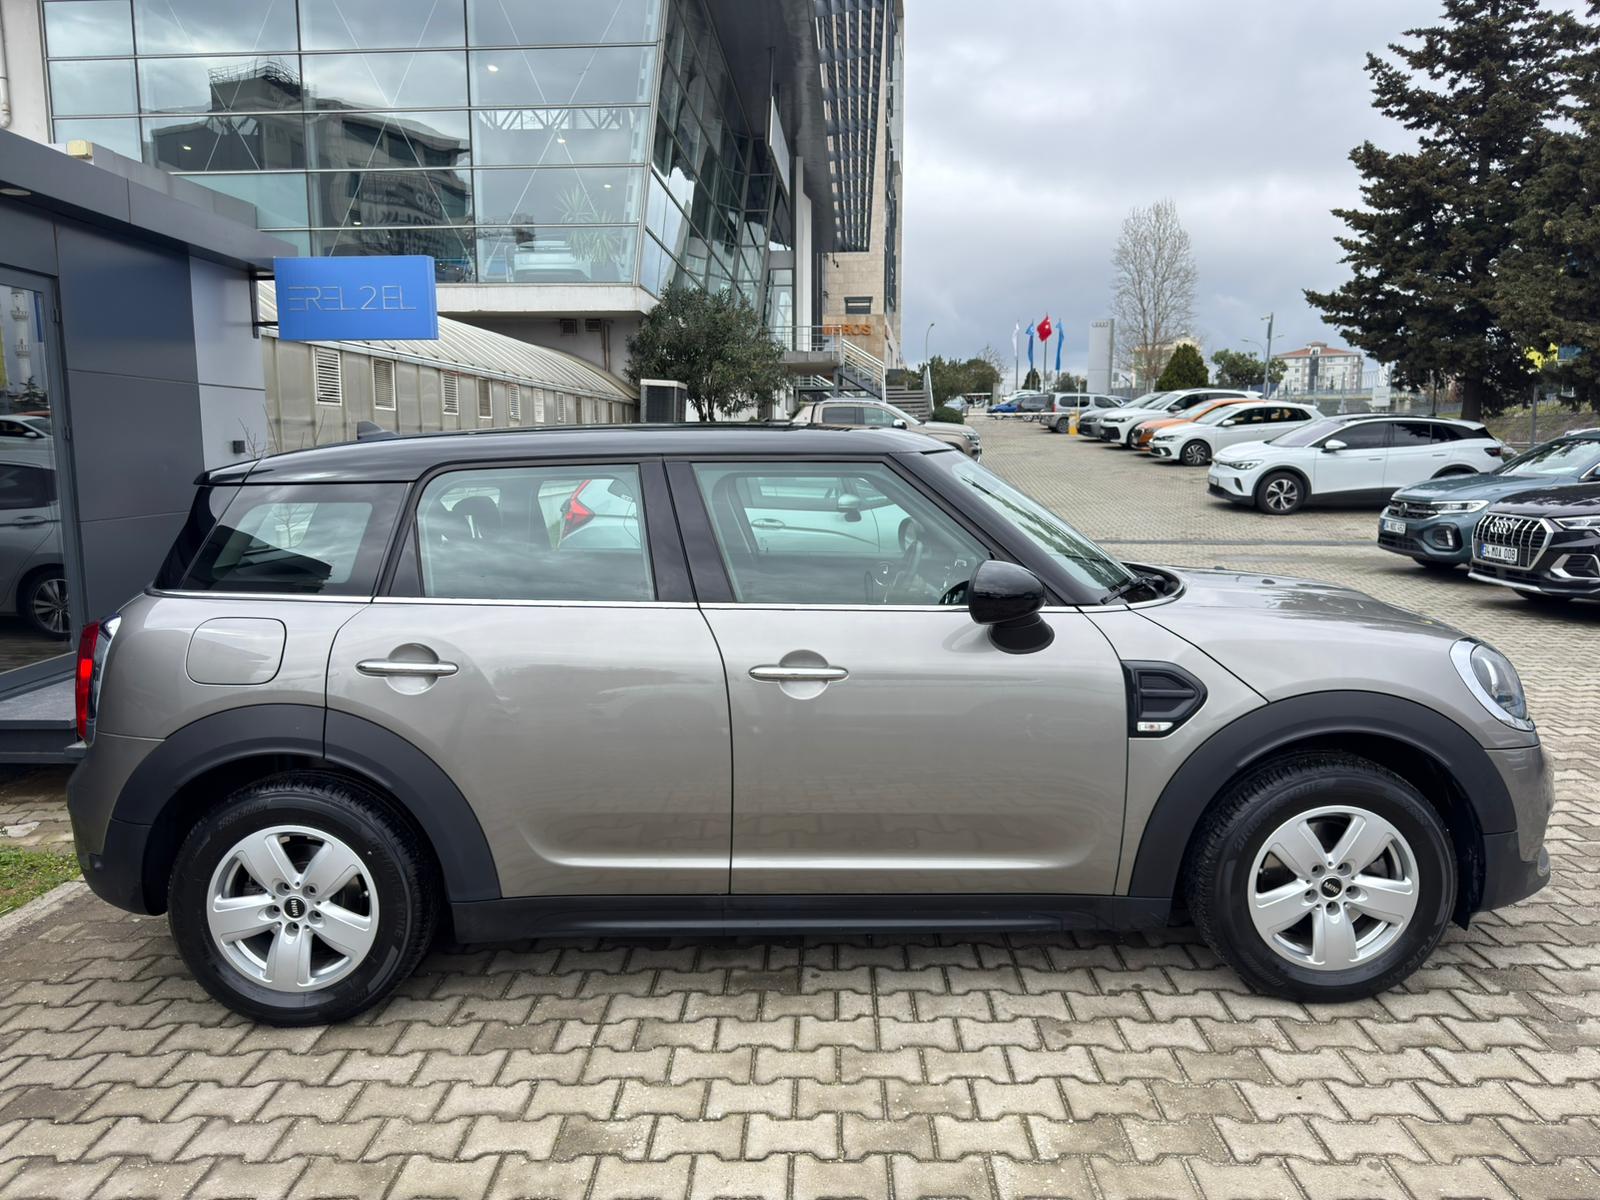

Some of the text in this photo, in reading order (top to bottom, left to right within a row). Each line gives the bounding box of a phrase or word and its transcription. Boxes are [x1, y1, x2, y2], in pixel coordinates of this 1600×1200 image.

[287, 285, 357, 311] EREL
[1323, 881, 1340, 894] MINI
[291, 900, 300, 917] MINI
